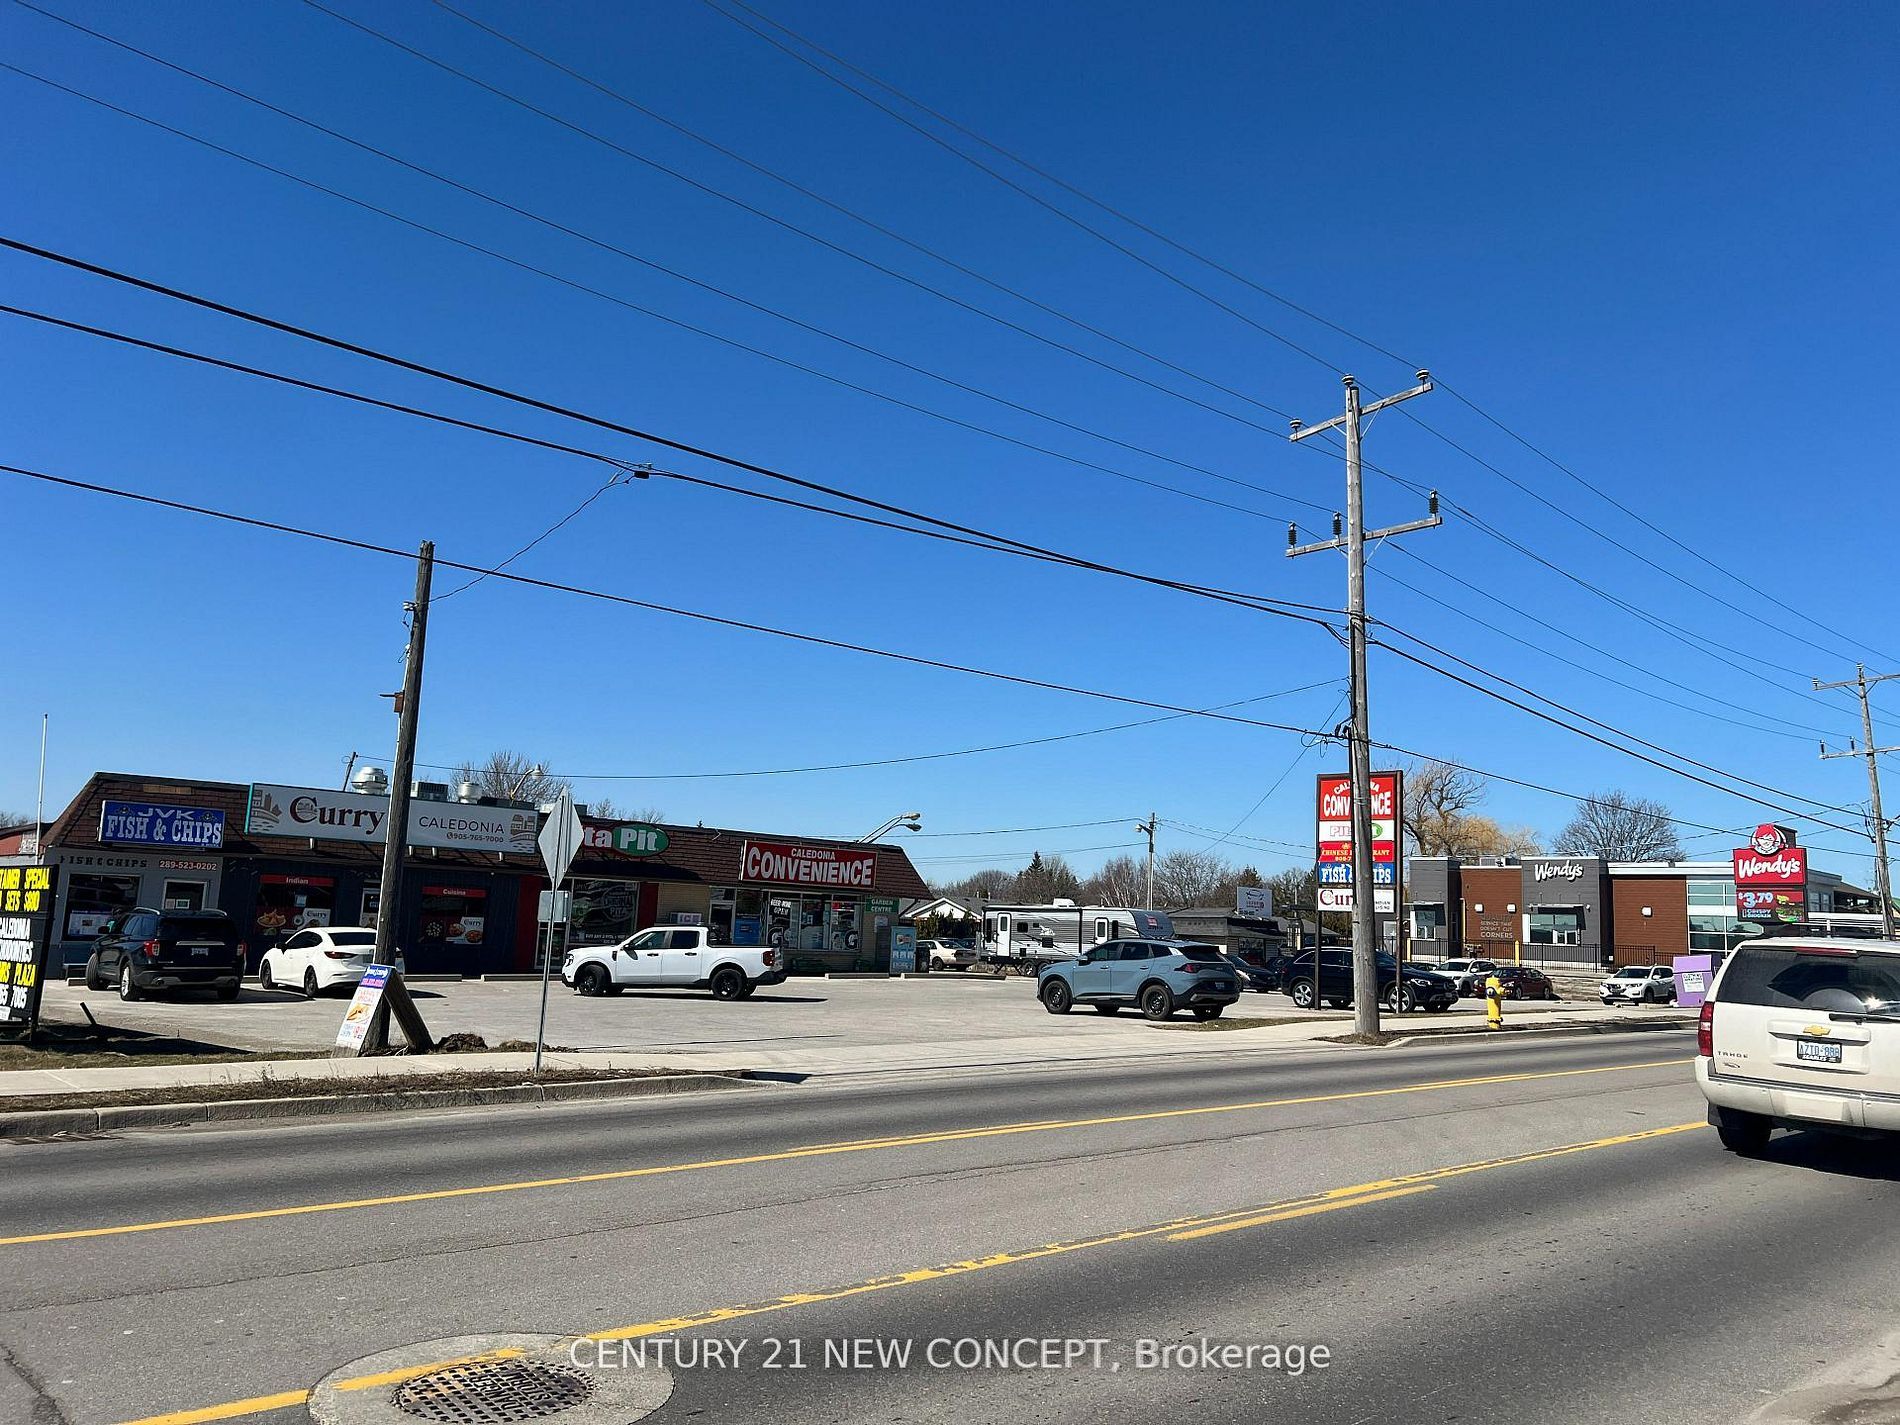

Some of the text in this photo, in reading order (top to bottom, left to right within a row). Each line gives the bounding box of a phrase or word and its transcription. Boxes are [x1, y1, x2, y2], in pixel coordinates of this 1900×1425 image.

[1323, 791, 1392, 817] CONVNCE
[138, 807, 195, 821] JVK
[289, 796, 385, 835] Curry
[105, 815, 222, 844] FISH & CHIPS
[418, 816, 505, 834] CALEDONIA
[583, 826, 658, 851] ta Pit
[106, 858, 148, 868] CHIPS
[791, 848, 836, 861] CALEDONIA
[159, 860, 217, 871] 289-523-0202
[746, 846, 874, 885] CONVENIENCE
[1534, 859, 1584, 882] Wendy's
[1738, 854, 1801, 879] Wendy's
[286, 877, 309, 885] Indian
[1321, 866, 1347, 883] FISH
[1320, 889, 1353, 906] Cur
[1738, 892, 1774, 908] $3.79
[1480, 931, 1514, 939] CORNERS
[13, 963, 36, 987] PLAZA
[1717, 1051, 1749, 1059] TAHOE
